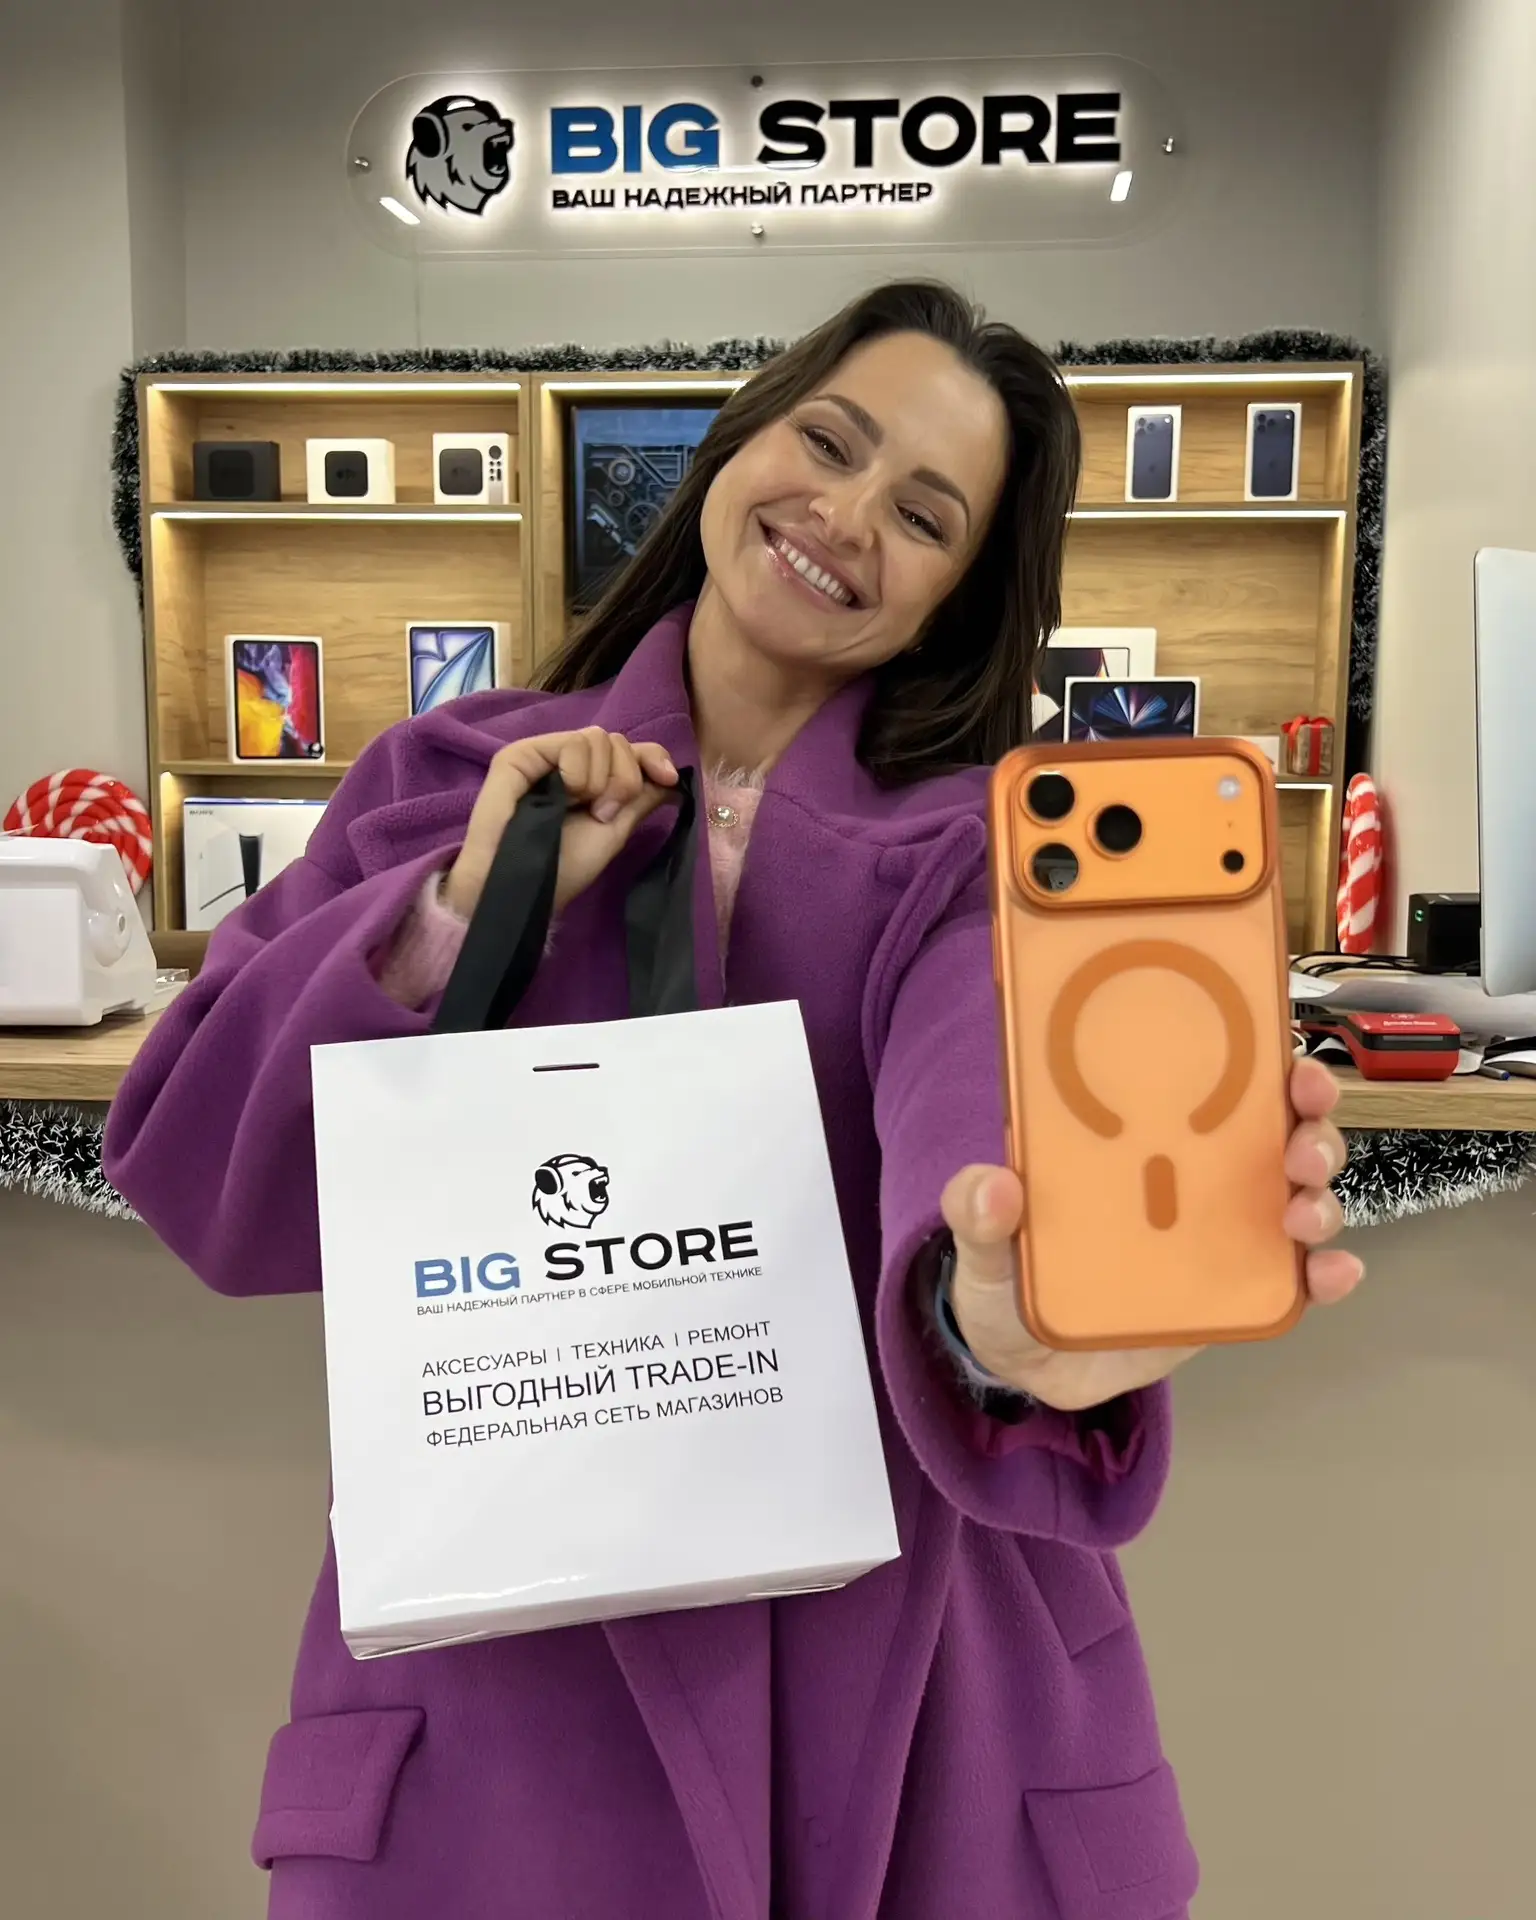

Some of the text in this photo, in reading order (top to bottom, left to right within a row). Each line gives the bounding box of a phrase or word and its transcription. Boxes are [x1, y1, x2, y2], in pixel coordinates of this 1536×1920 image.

[550, 92, 1122, 173] BIG STORE
[552, 181, 933, 210] ВАШ НАДЕЖНЫЙ ПАРТНЕР
[414, 1220, 759, 1298] BIG STORE
[416, 1266, 763, 1316] ВАШ НАДЕЖНЫЙ ПАРТНЕР В СФЕРЕ МОБИЛЬНОЙ ТЕХНИКЕ
[421, 1348, 547, 1378] АКСЕСУАРЫ
[570, 1334, 665, 1360] ТЕХНИКА
[687, 1320, 771, 1346] РЕМОНТ
[422, 1347, 780, 1417] ВЫГОДНЫЙ TRADE-IN
[426, 1386, 784, 1447] ФЕДЕРАЛЬНАЯ СЕТЬ МАГАЗИНОВ
